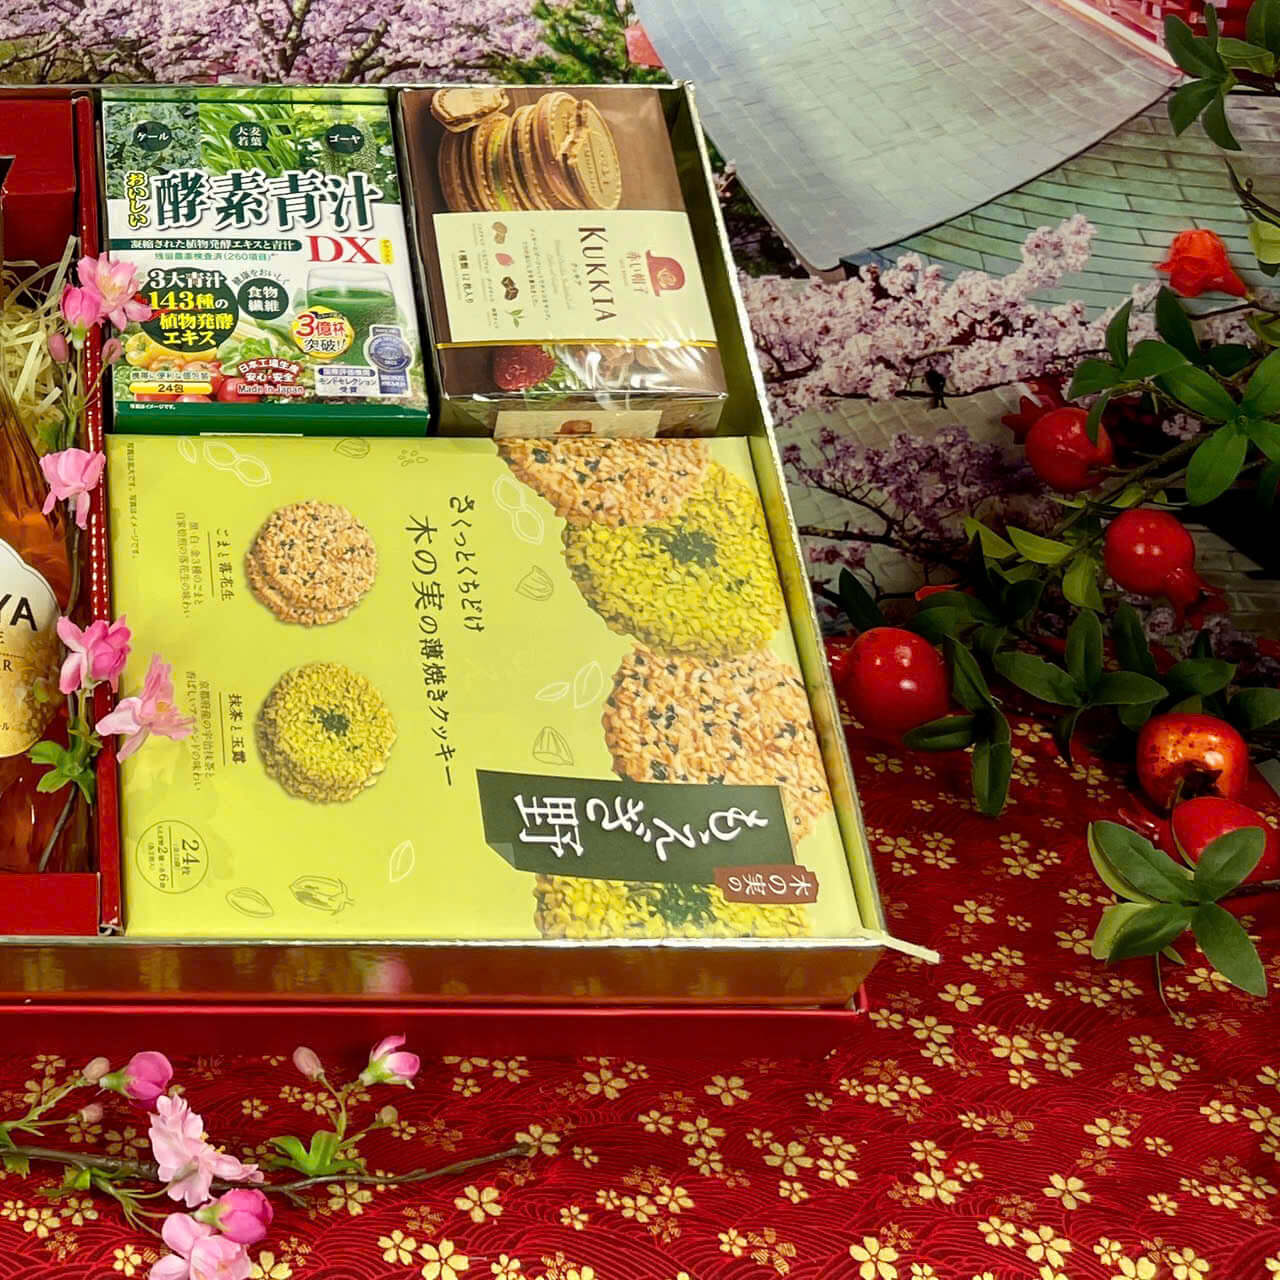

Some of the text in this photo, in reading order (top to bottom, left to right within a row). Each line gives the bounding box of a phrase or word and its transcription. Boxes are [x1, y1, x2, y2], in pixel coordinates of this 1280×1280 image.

[136, 132, 168, 142] ケール
[328, 133, 361, 144] ゴーヤ
[126, 172, 148, 227] おいしい
[153, 171, 379, 229] 酵素青汁
[308, 235, 380, 265] DX
[150, 270, 224, 289] 3大青汁
[578, 227, 617, 322] KUKKIA
[149, 291, 228, 310] 143種の
[247, 285, 279, 299] 食物
[247, 299, 280, 312] 繊維
[160, 313, 234, 330] 植物発酵
[295, 313, 345, 337] 3億杯
[162, 331, 217, 346] エキス
[158, 383, 184, 393] 24包
[277, 384, 303, 395] Japan
[216, 528, 235, 601] ごまと落花生
[449, 495, 485, 632] さくっとくちどけ
[405, 515, 456, 786] 木の実の薄焼きクッキー
[228, 693, 247, 764] 抹茶と玉露
[513, 794, 769, 862] もえぎ野
[727, 873, 813, 896] 木の実の
